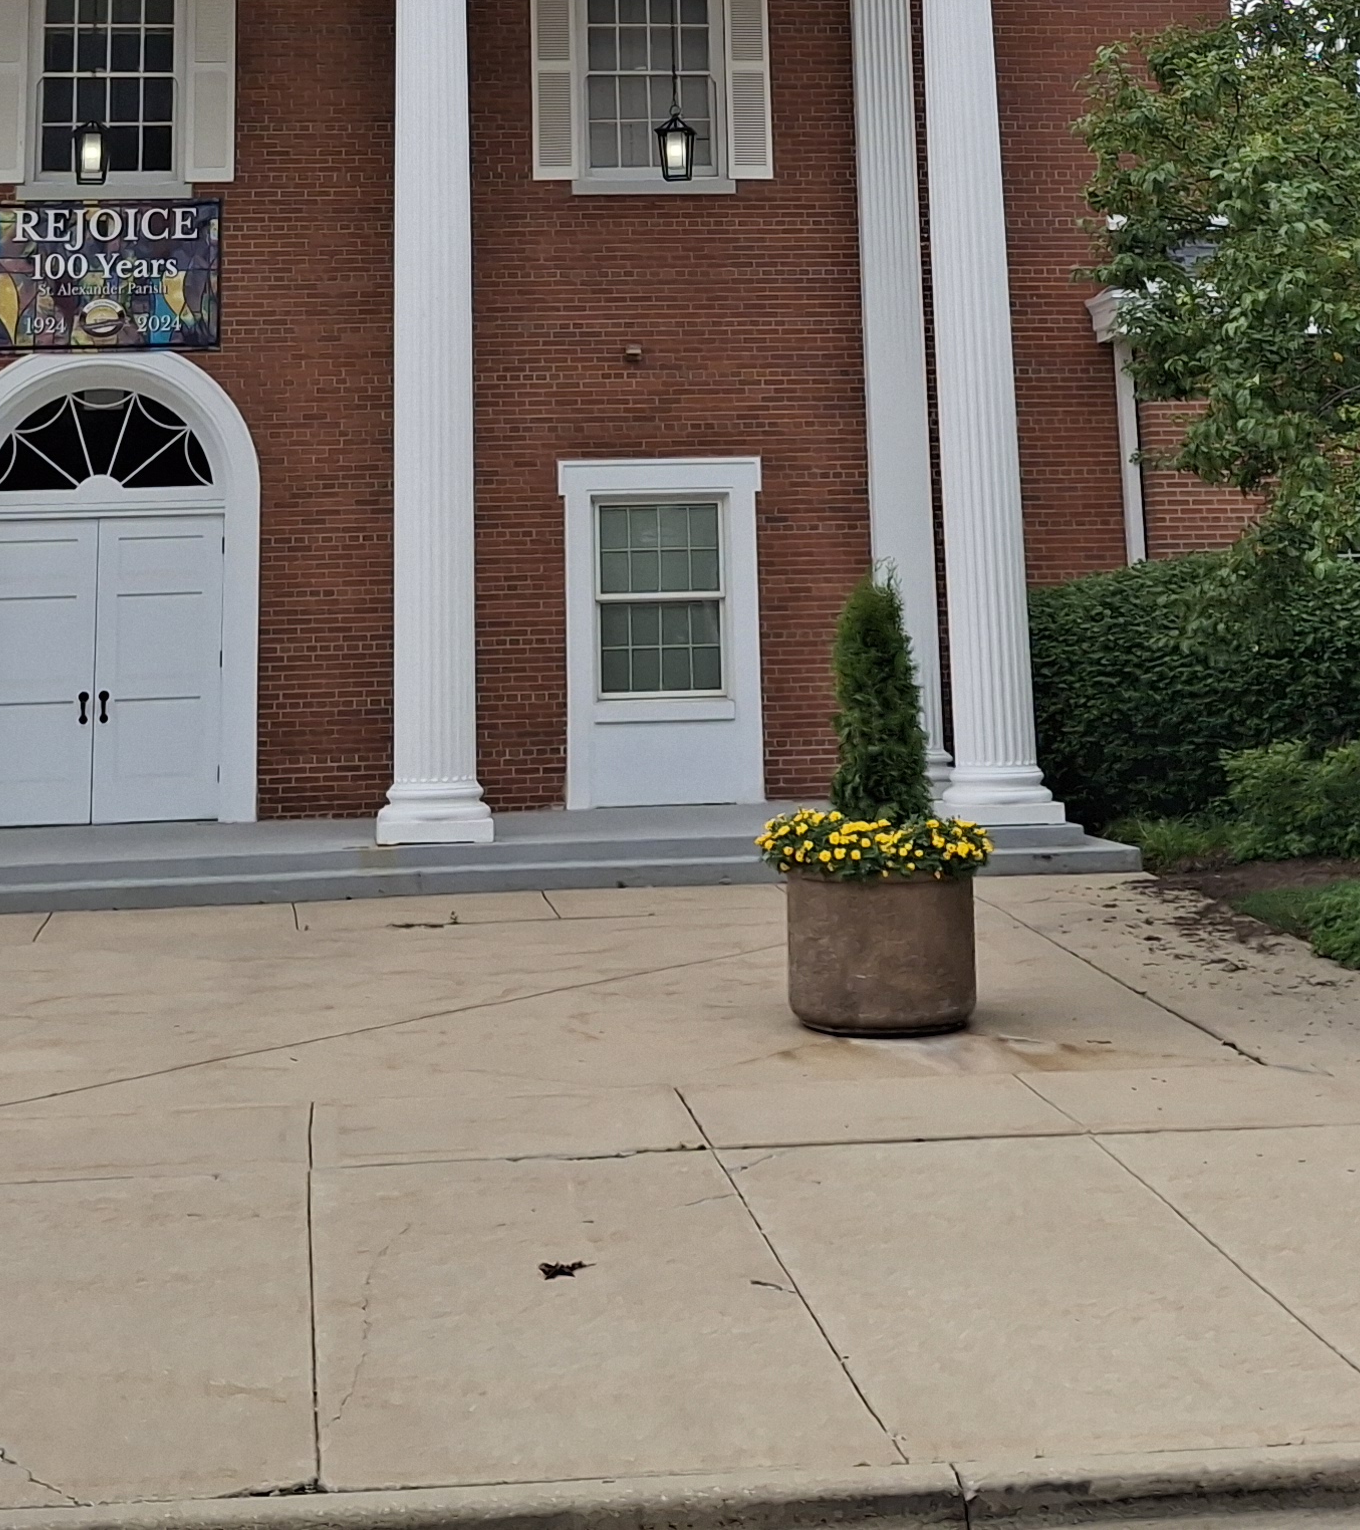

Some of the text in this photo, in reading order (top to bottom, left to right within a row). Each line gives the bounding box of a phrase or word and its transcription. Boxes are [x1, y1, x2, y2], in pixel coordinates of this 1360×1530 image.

[12, 207, 198, 251] REJOICE
[31, 252, 178, 280] 100 Years
[38, 281, 168, 296] St. Alexander Parish
[25, 317, 67, 335] 1924
[137, 314, 181, 333] 2024
